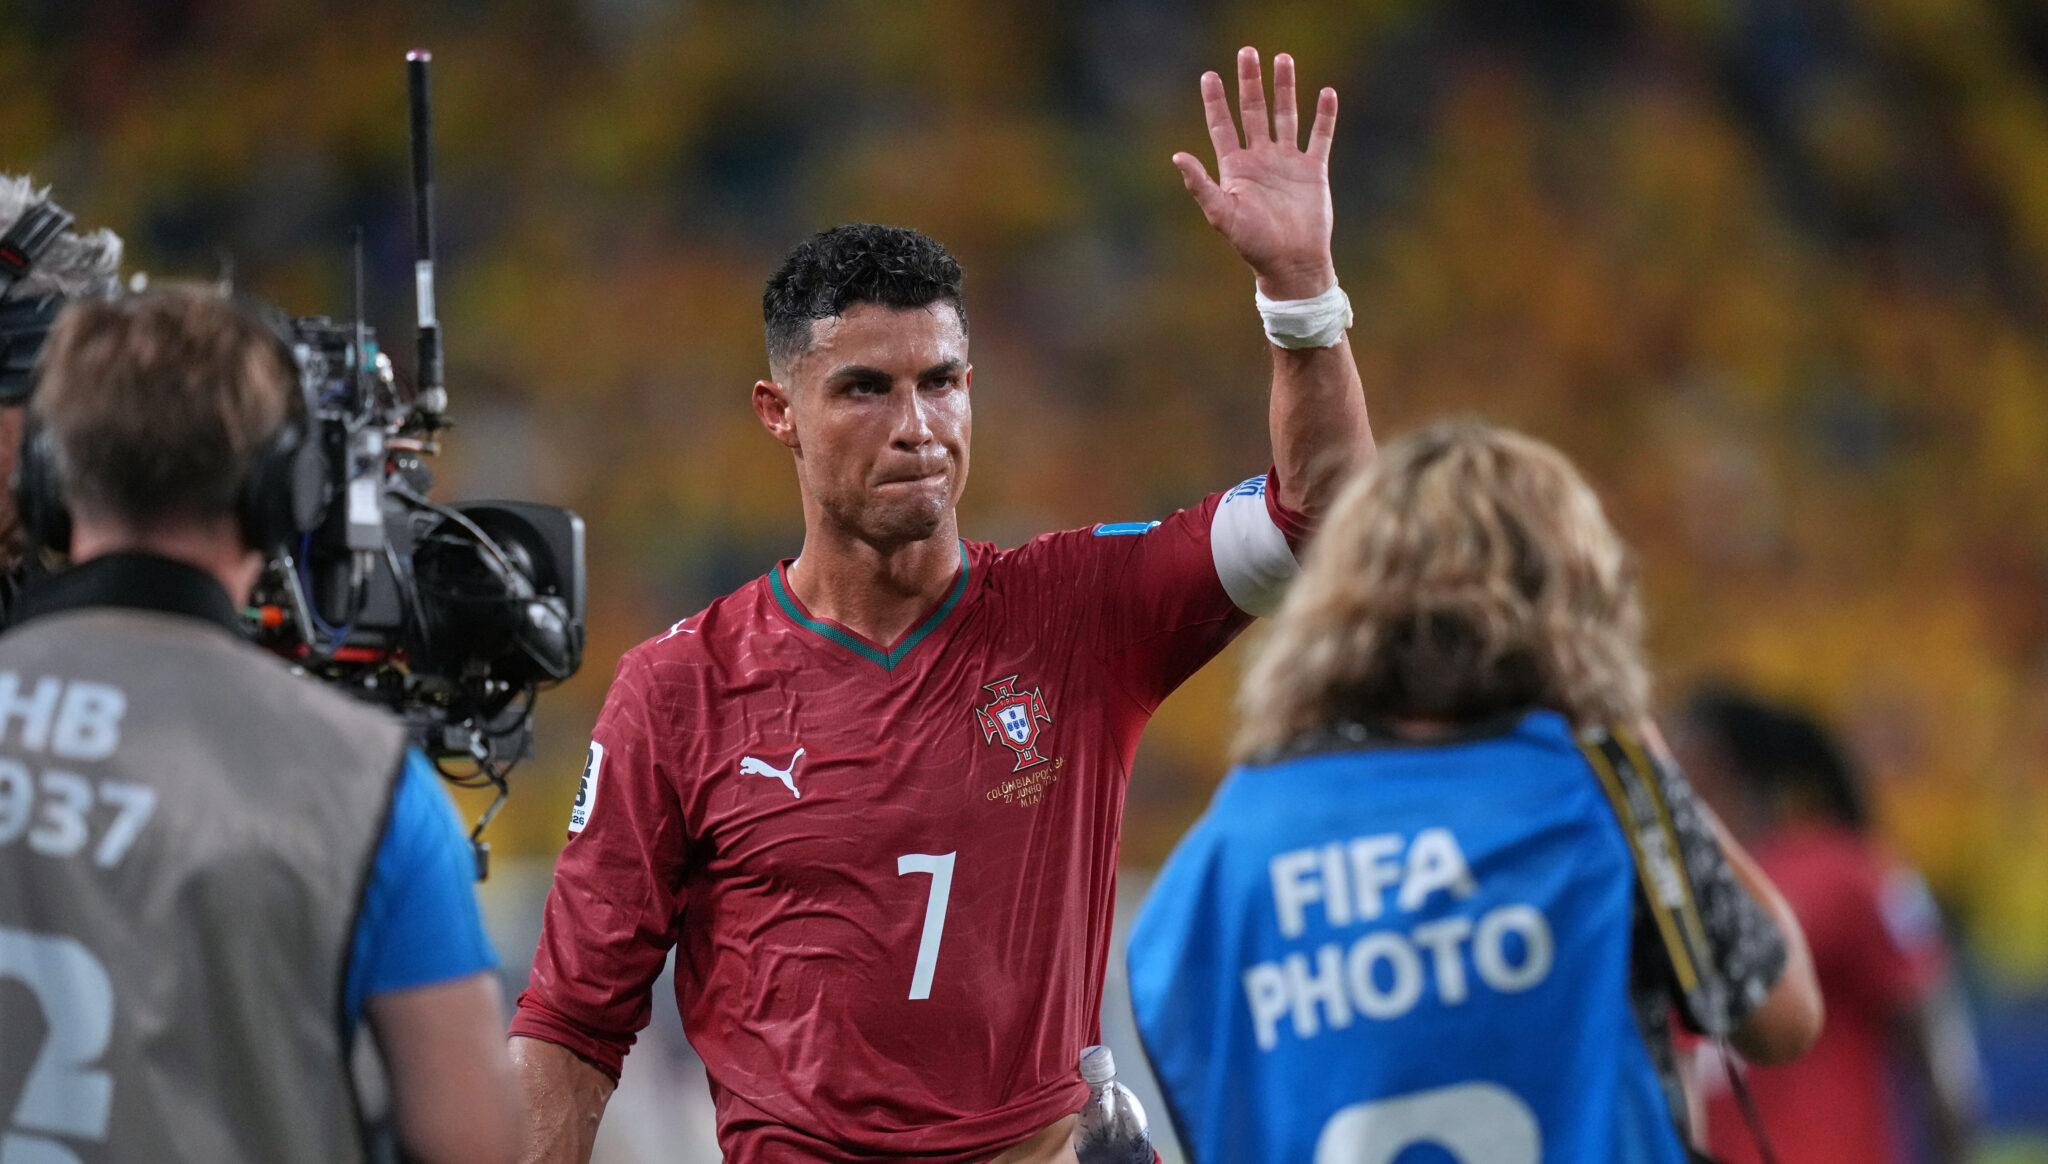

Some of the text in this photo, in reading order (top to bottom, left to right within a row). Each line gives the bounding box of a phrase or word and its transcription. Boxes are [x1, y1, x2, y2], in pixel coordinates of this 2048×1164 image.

[0, 671, 128, 761] HB
[1004, 793, 1013, 804] 27
[1016, 783, 1042, 800] JUNHO
[897, 850, 957, 1000] 7
[1268, 827, 1480, 940] FIFA
[1244, 904, 1556, 1053] PHOTO
